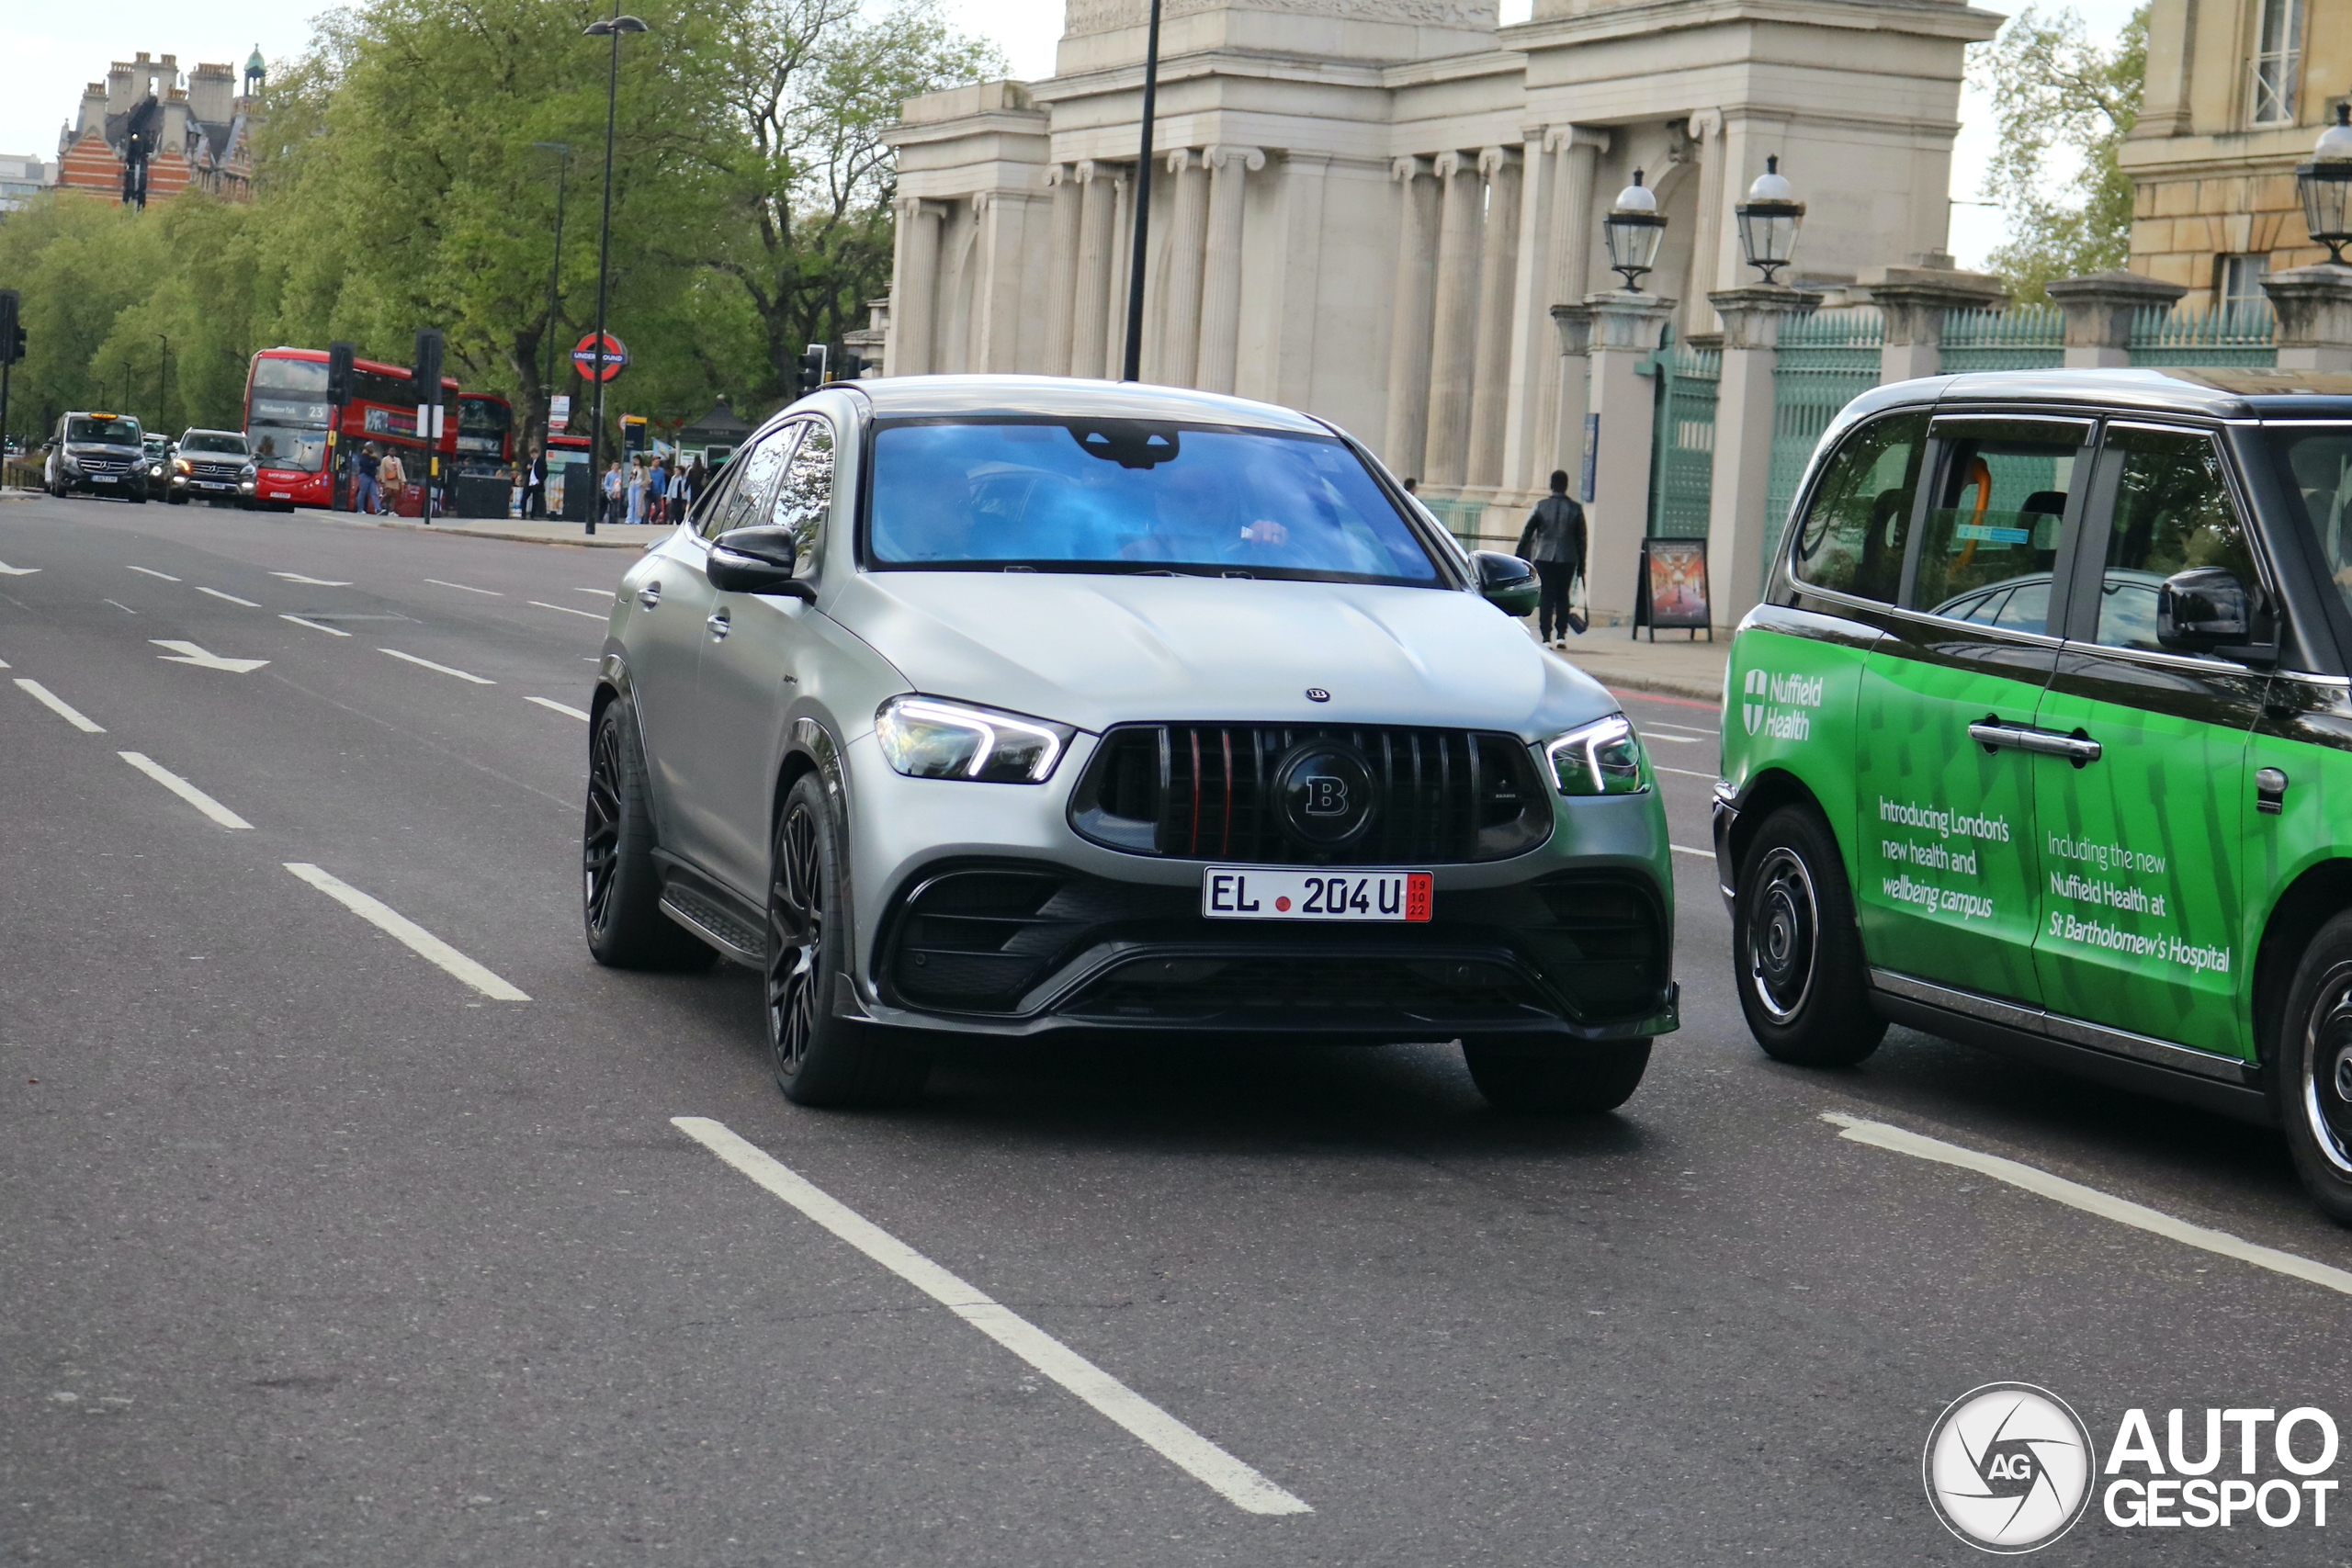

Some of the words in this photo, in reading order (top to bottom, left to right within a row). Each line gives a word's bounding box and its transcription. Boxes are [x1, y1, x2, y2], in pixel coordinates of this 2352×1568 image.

[573, 352, 623, 362] UNDEROUND
[309, 406, 323, 418] 23
[1770, 671, 1824, 707] Nuffield
[1766, 711, 1811, 741] Health
[1305, 774, 1350, 817] B
[1880, 795, 1950, 839] Introducing
[1951, 807, 2010, 843] London's
[1883, 840, 1907, 862] new
[1909, 838, 1950, 871] health
[1951, 849, 1977, 875] and
[2048, 830, 2109, 871] Including
[2110, 842, 2132, 869] the
[2135, 852, 2166, 874] new
[1212, 875, 1260, 911] EL
[1302, 877, 1370, 914] 204
[1379, 878, 1401, 914] U
[1411, 879, 1426, 890] 19
[1411, 892, 1425, 902] 10
[1883, 874, 1940, 914] wellbeing
[1940, 889, 1993, 920] campus
[2050, 871, 2102, 905] Nuffield
[2103, 881, 2148, 913] Health
[2150, 894, 2166, 917] at
[1409, 905, 1425, 915] 22
[2049, 911, 2064, 937] St
[2064, 914, 2166, 960] Bartholomew's
[2168, 935, 2230, 974] Hospital
